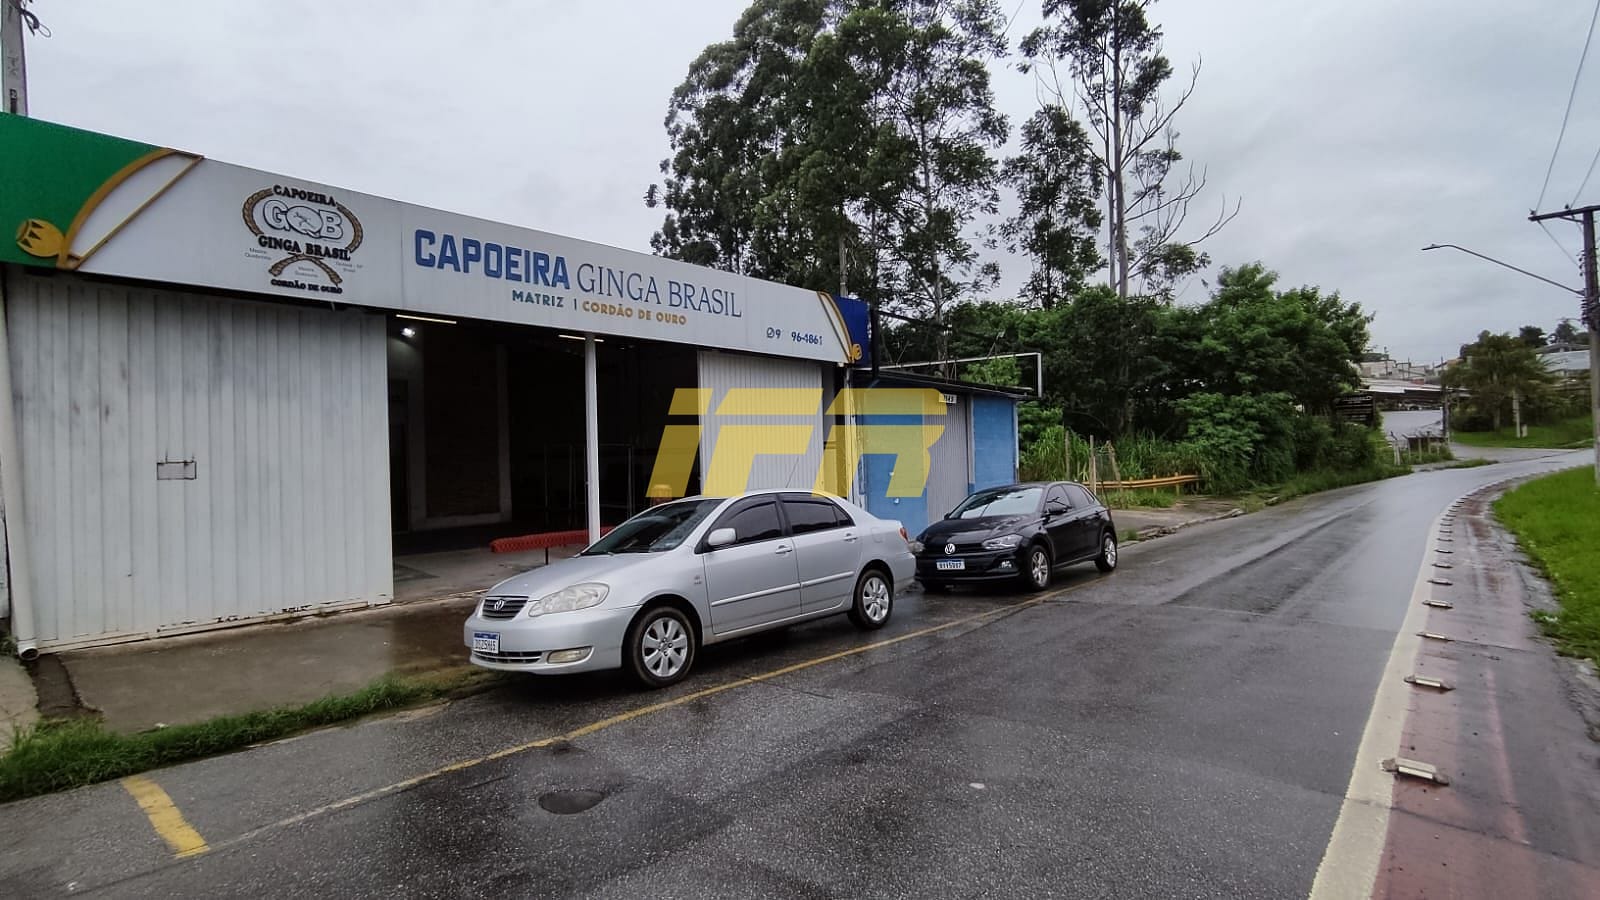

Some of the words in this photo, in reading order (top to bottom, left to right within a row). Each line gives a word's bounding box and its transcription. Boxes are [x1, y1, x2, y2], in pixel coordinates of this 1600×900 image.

[273, 184, 336, 206] CAPOEIRA
[258, 236, 301, 253] GINGA
[305, 242, 351, 261] BRASIL
[414, 228, 571, 290] CAPOEIRA
[576, 262, 662, 305] GINGA
[669, 279, 742, 319] BRASIL
[270, 278, 306, 291] CORDÃO
[308, 284, 320, 292] DE
[321, 286, 343, 295] OURO
[511, 289, 565, 309] MATRIZ
[582, 300, 634, 320] CORDÃO
[638, 310, 652, 321] DE
[656, 313, 687, 326] OURO
